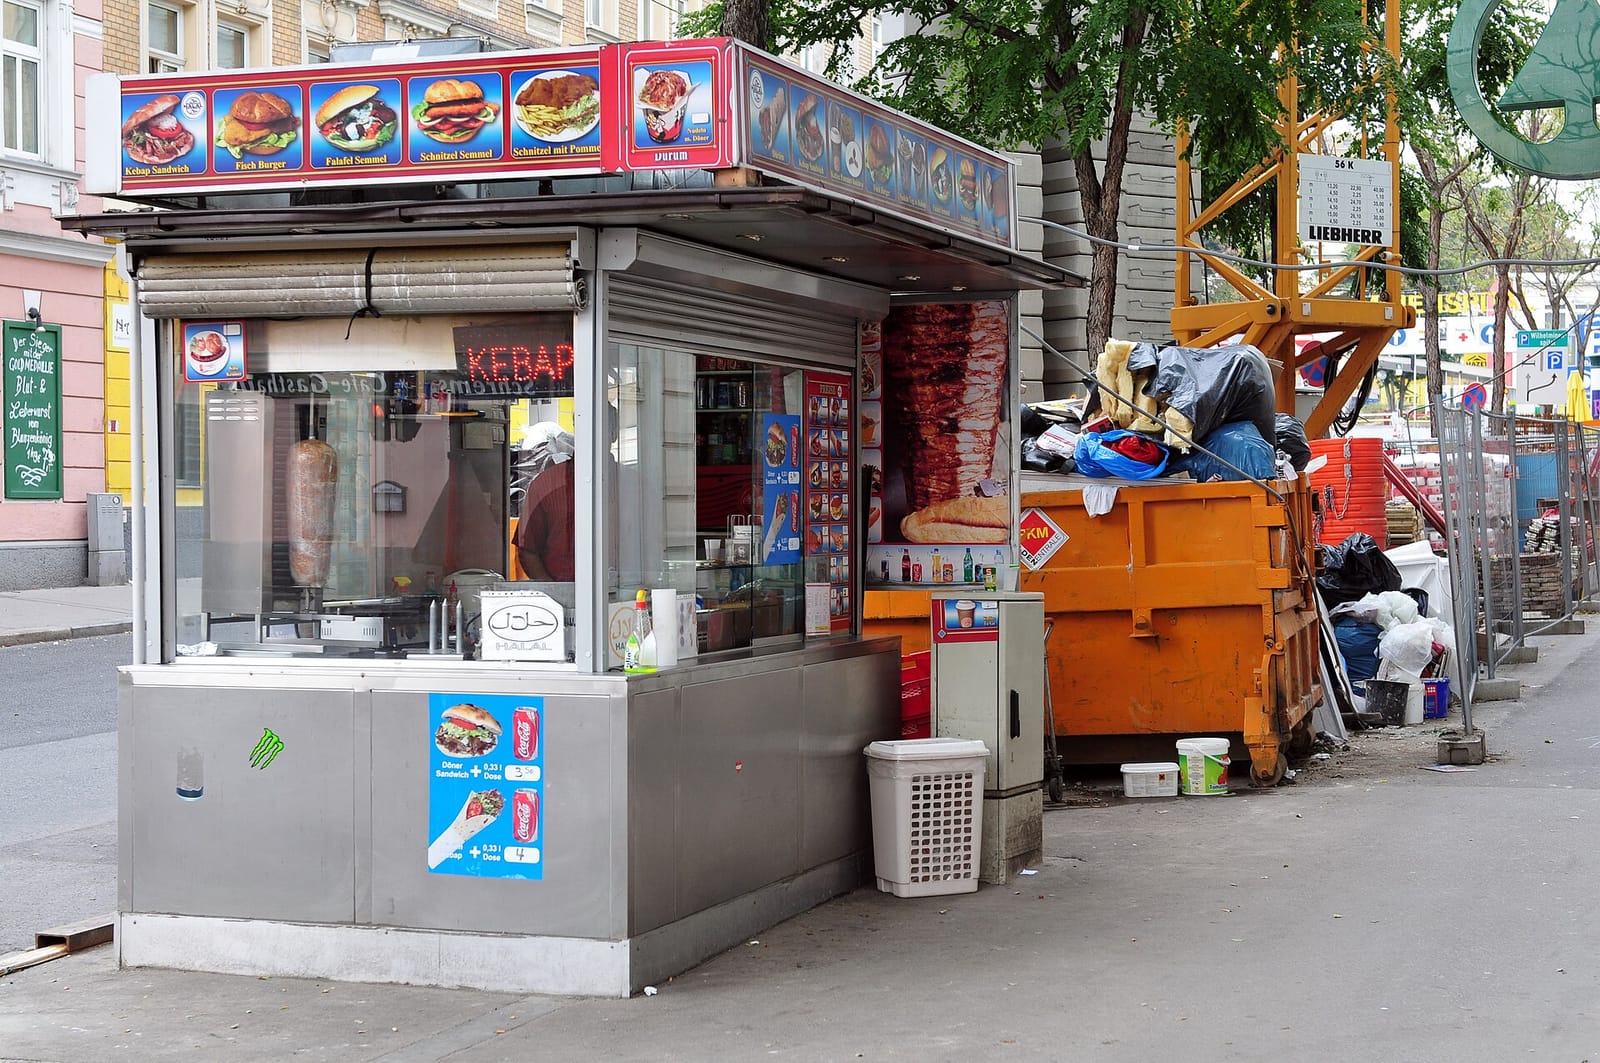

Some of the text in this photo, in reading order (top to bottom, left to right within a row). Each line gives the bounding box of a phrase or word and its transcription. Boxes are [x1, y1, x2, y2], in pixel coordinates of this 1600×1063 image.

[420, 148, 493, 161] Schnitzel Semmel
[513, 143, 600, 156] Schnitzel mit Pomme
[235, 160, 287, 171] Fisch Burger
[326, 154, 387, 167] Falafel Semmel
[1334, 159, 1354, 170] 56 K
[125, 164, 190, 176] Kebap Sandwich
[1309, 226, 1382, 244] LIEBHERR
[13, 337, 27, 353] Der
[466, 344, 575, 383] KEBAP
[39, 378, 47, 393] &
[495, 642, 553, 651] HALAL
[441, 761, 464, 769] Döner
[483, 763, 498, 772] 0,33
[435, 769, 469, 779] Sandwich
[483, 772, 502, 780] Dose
[482, 844, 498, 853] 0,33
[516, 847, 525, 861] 4
[482, 853, 501, 861] Dose
